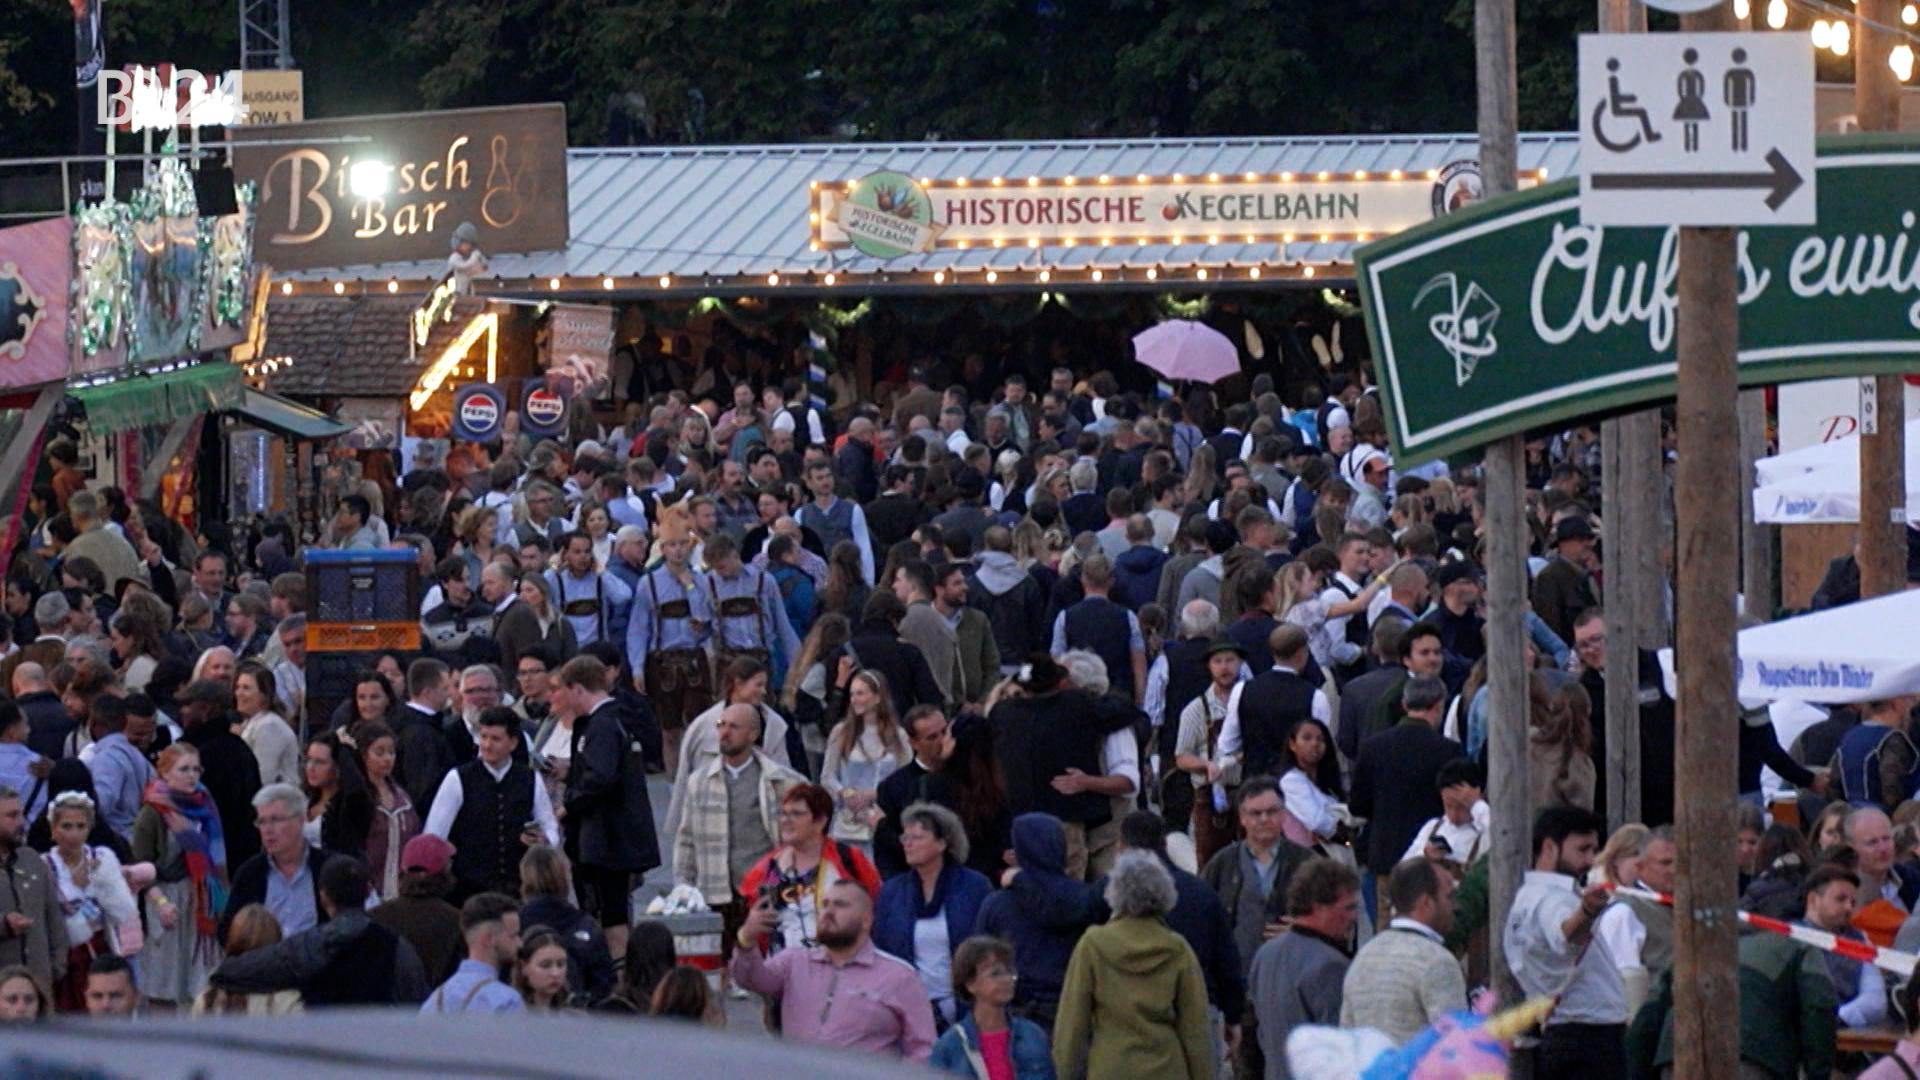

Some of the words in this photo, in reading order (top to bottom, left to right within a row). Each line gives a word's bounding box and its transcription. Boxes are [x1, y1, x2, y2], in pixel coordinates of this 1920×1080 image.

[263, 136, 471, 244] Bisch
[946, 197, 1145, 225] HISTORISCHE
[1175, 192, 1359, 221] KEGELBAHN
[352, 198, 448, 239] Bar
[1789, 211, 1920, 330] ewi
[463, 407, 496, 418] PEPSI
[530, 401, 561, 411] PEPSI
